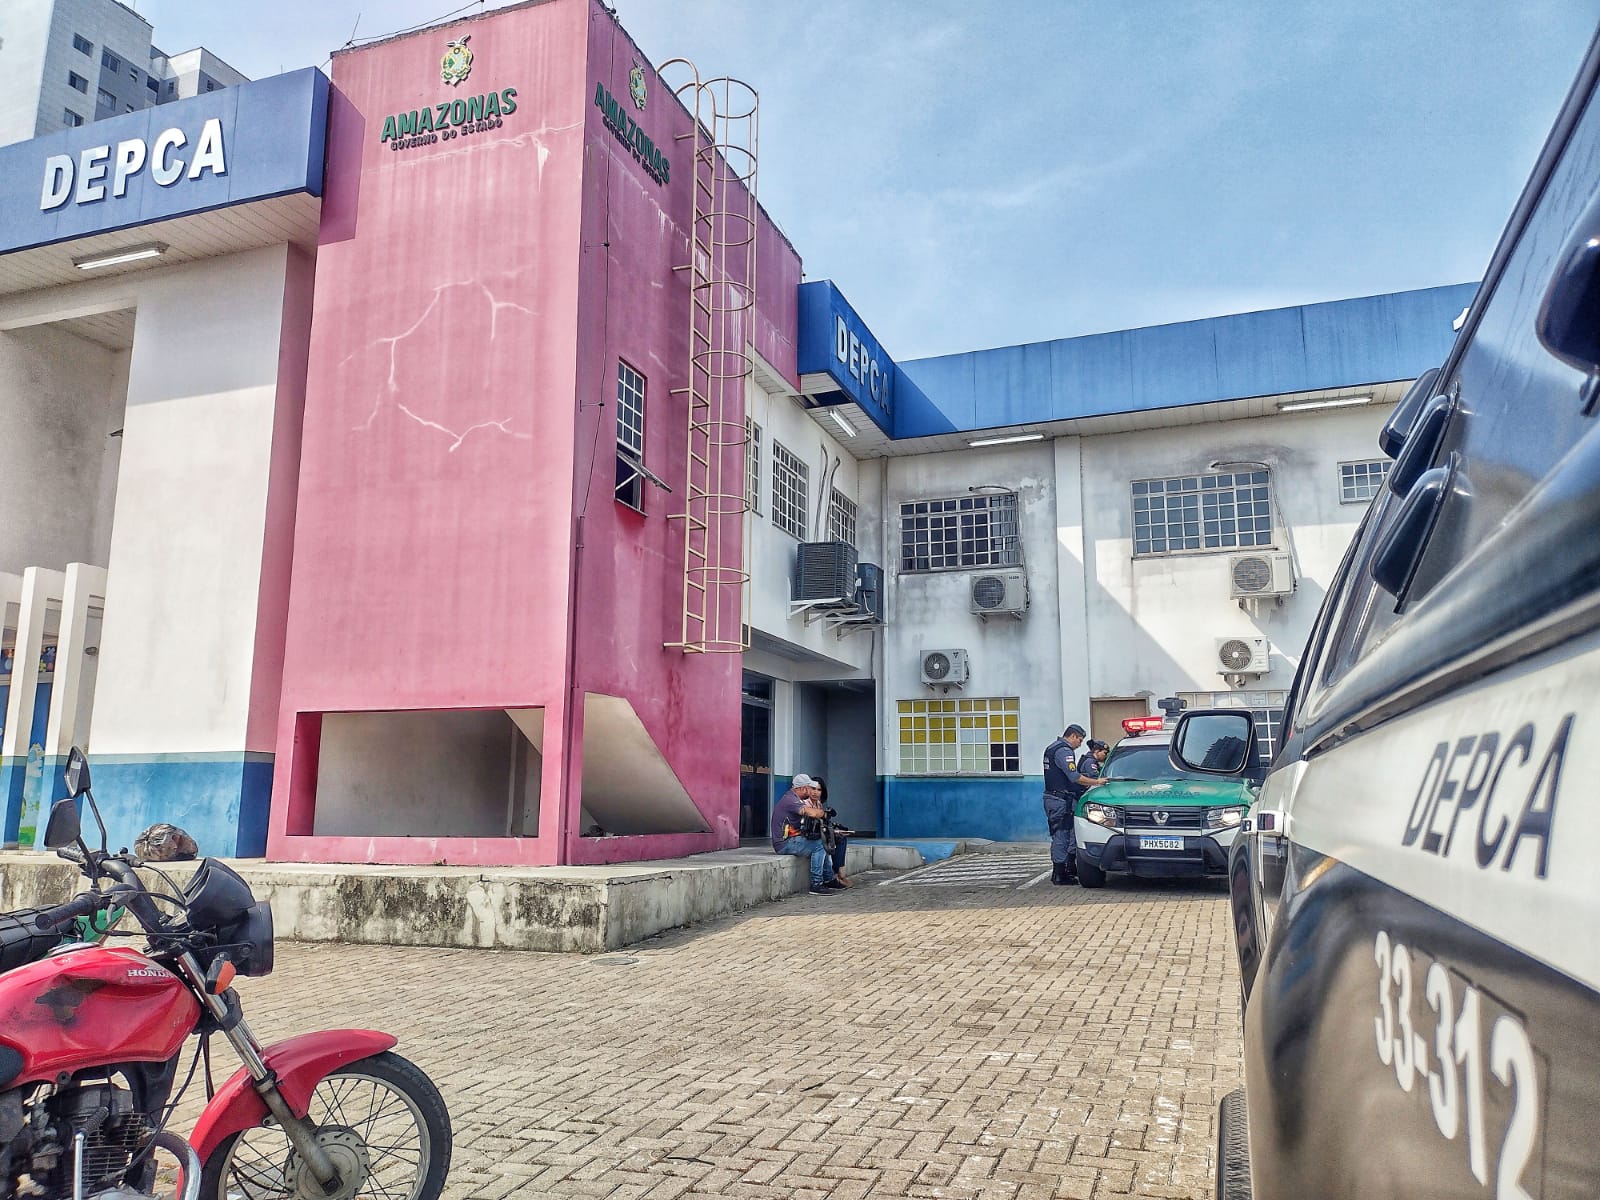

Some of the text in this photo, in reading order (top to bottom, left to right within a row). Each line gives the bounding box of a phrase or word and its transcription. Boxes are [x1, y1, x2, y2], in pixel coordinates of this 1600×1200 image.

[40, 118, 227, 212] DEPCA
[381, 88, 517, 143] AMAZONAS
[390, 118, 503, 151] GOVERNO DO ESTADO
[595, 81, 670, 184] AMAZONAS
[836, 314, 891, 416] DEPCA
[1402, 712, 1576, 880] DEPCA
[1374, 930, 1538, 1200] 33-312
